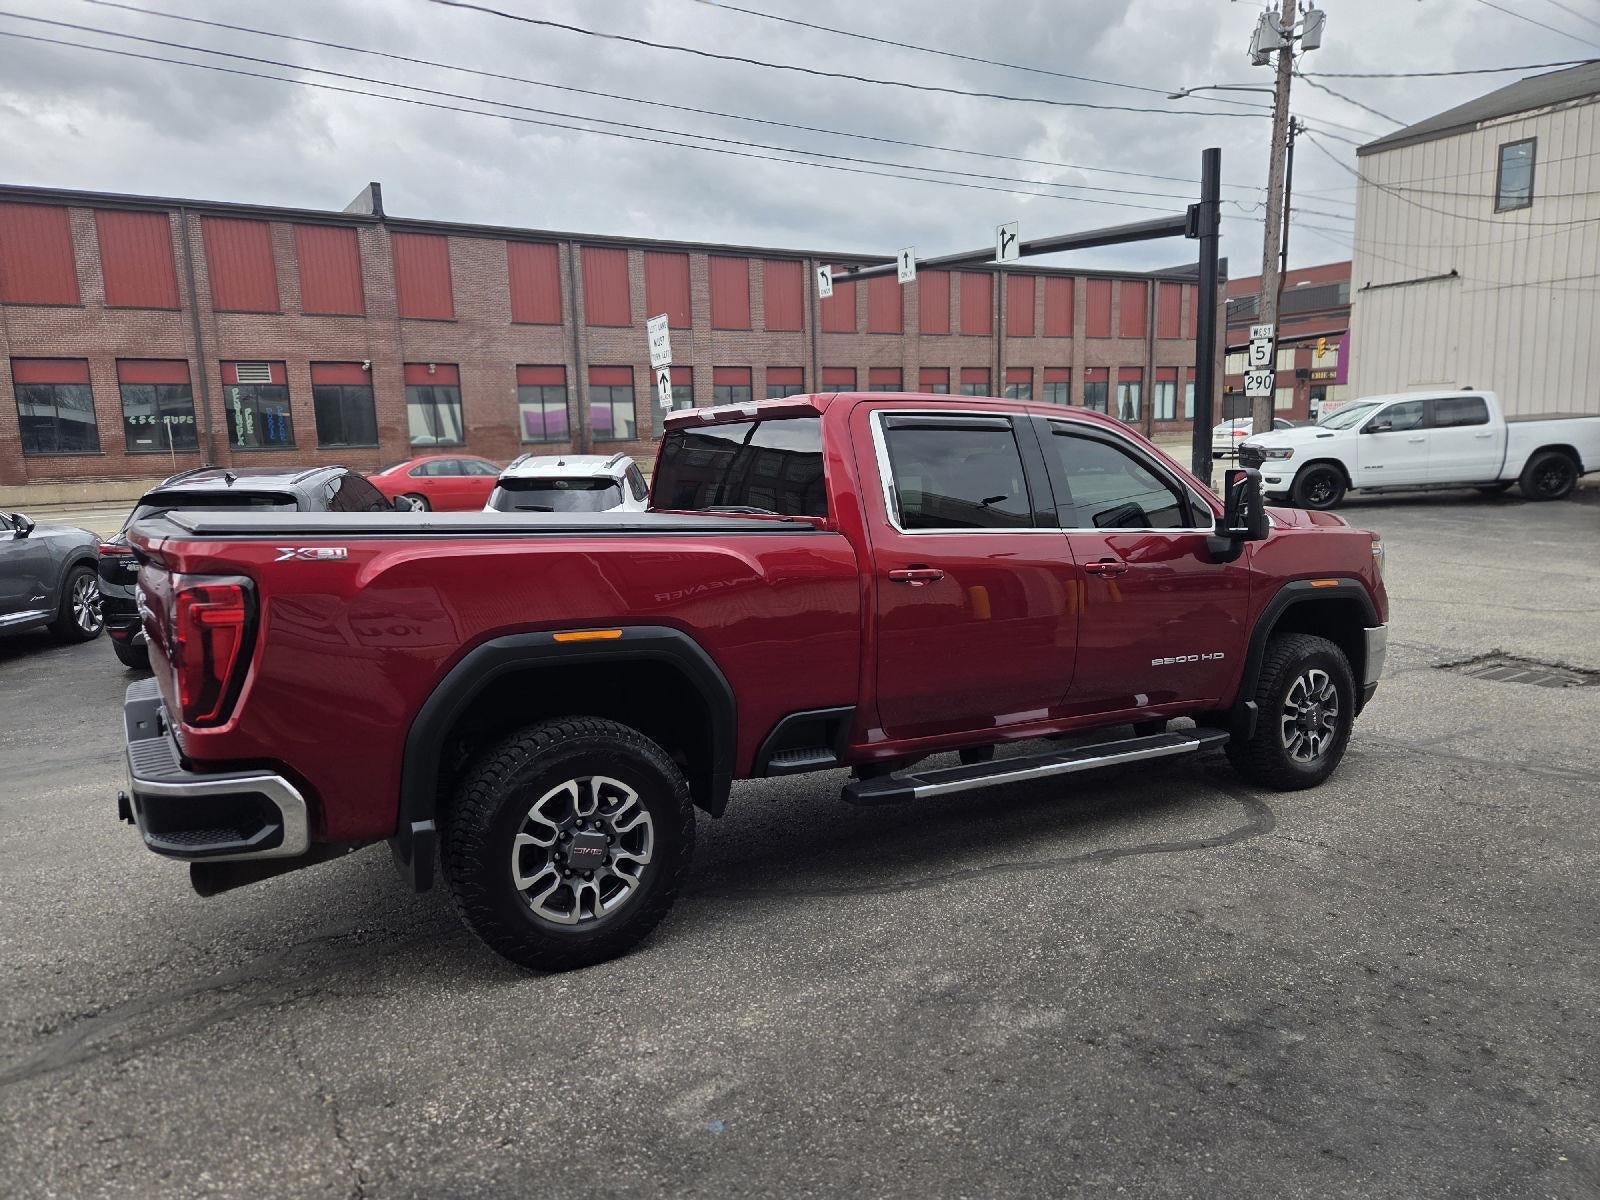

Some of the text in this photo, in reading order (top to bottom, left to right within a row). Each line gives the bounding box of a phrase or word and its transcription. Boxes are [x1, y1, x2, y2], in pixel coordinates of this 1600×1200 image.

[1253, 328, 1271, 337] WEST
[653, 336, 665, 347] MUST
[1256, 346, 1265, 360] 5
[1247, 375, 1272, 390] 290
[574, 847, 602, 855] GMC
